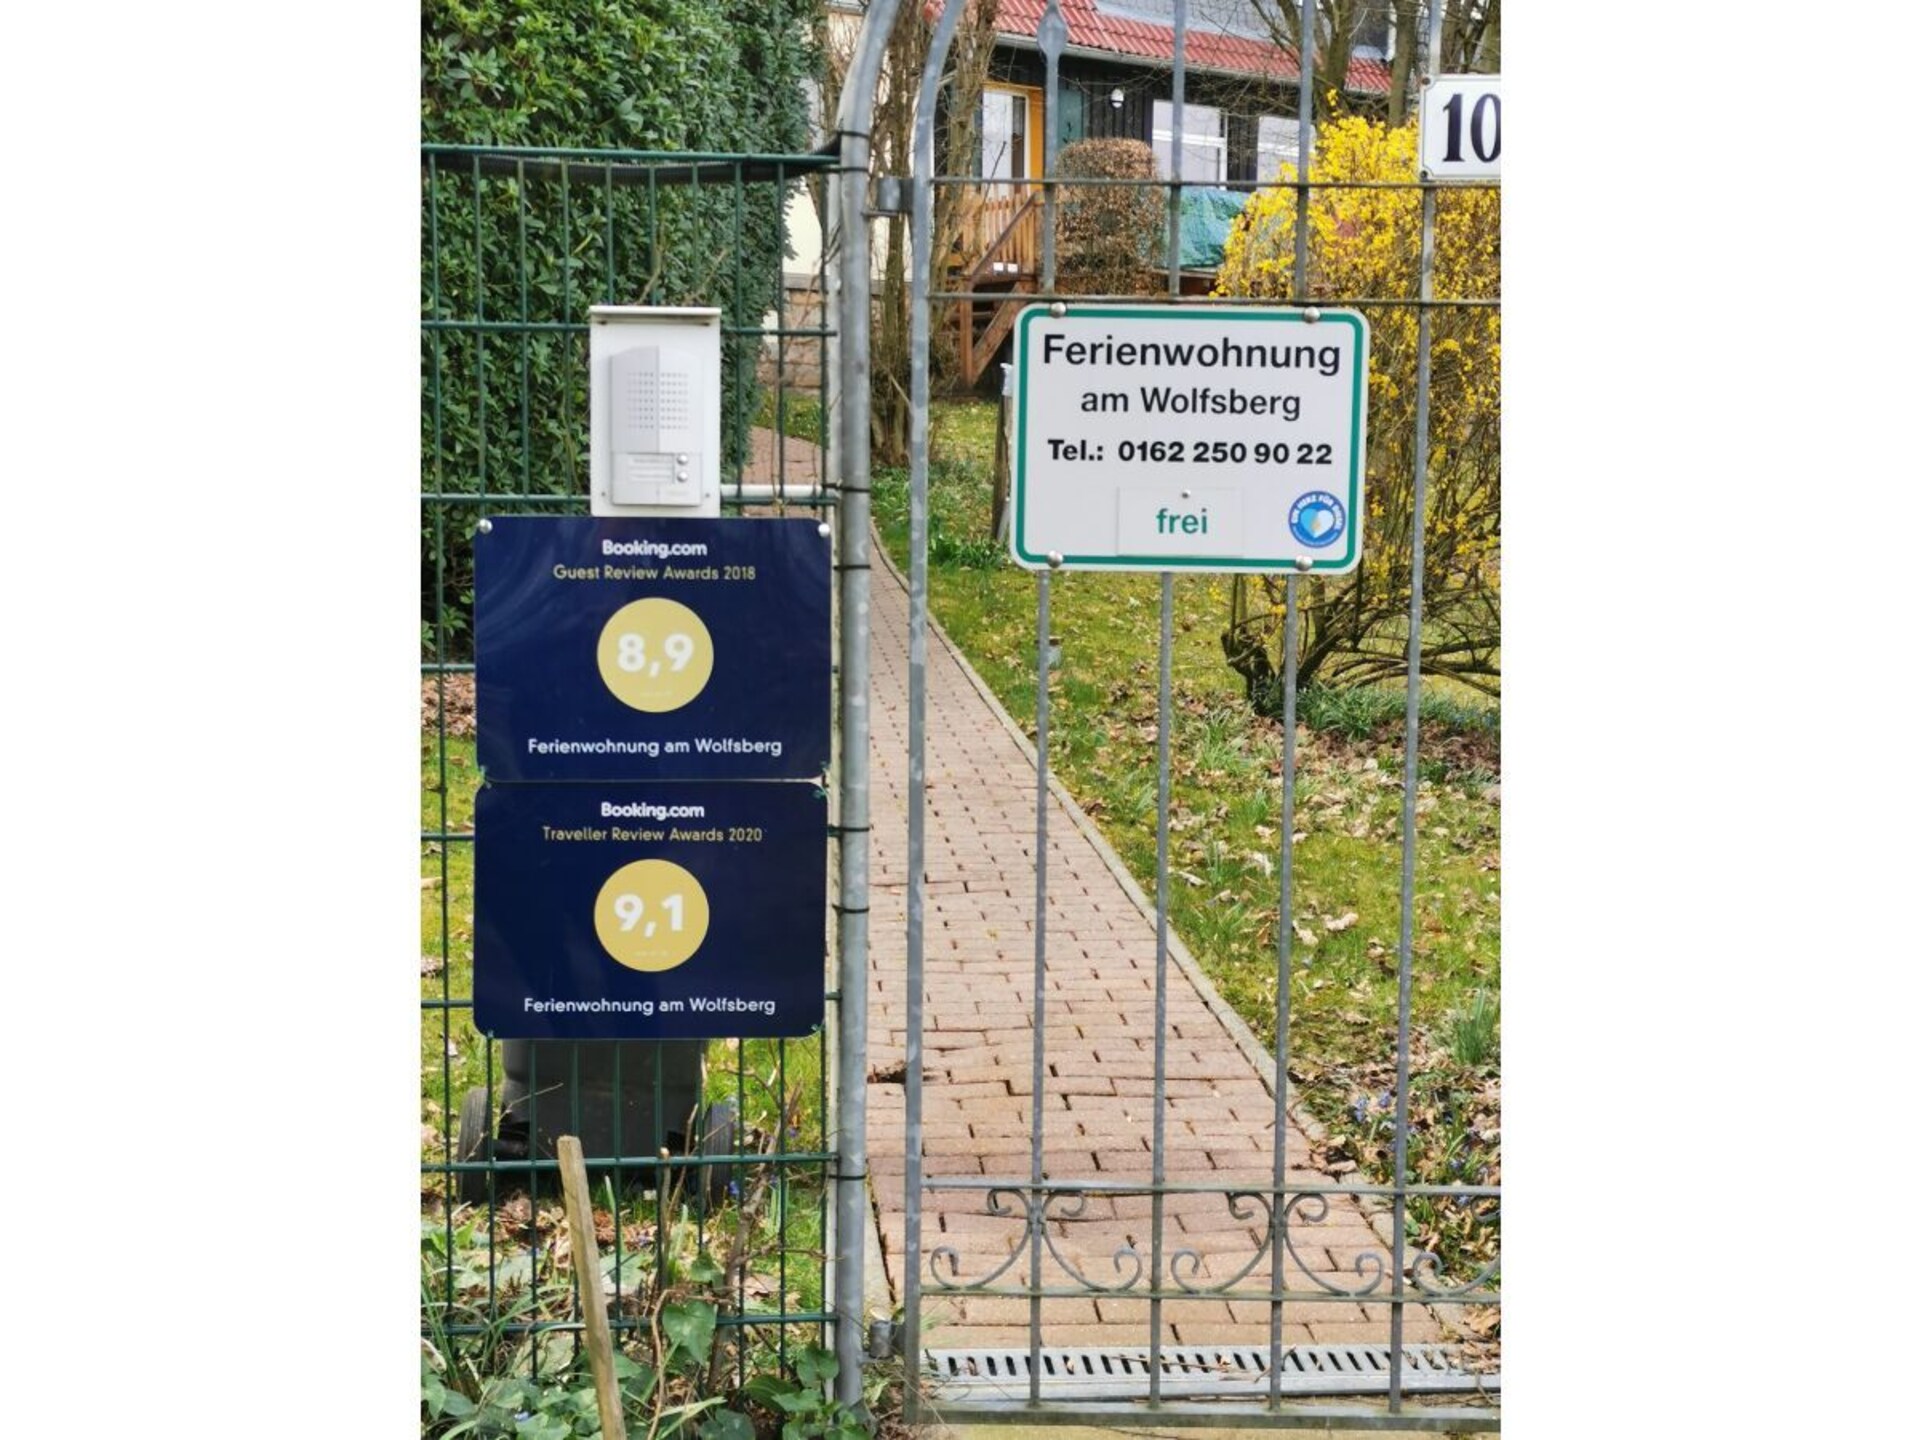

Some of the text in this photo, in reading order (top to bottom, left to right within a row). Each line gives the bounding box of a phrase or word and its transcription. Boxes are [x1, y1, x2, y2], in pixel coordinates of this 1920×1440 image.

[1443, 94, 1501, 163] 10
[1044, 334, 1339, 376] Ferienwohnung
[1081, 387, 1300, 421] am Wolfsberg
[1048, 439, 1331, 464] Tel.: 0162 250 90 22
[1157, 508, 1207, 534] frei
[603, 540, 707, 558] Booking.com
[553, 564, 755, 579] Guest Review Awards 2018
[617, 633, 695, 678] 8,9
[529, 738, 781, 757] Ferienwohnung am Wolfsberg
[602, 802, 704, 820] Booking.com
[543, 826, 762, 841] Traveller Review Awards 2020
[614, 894, 685, 938] 9,1
[525, 998, 775, 1016] Ferienwohnung am Wolfsberg
